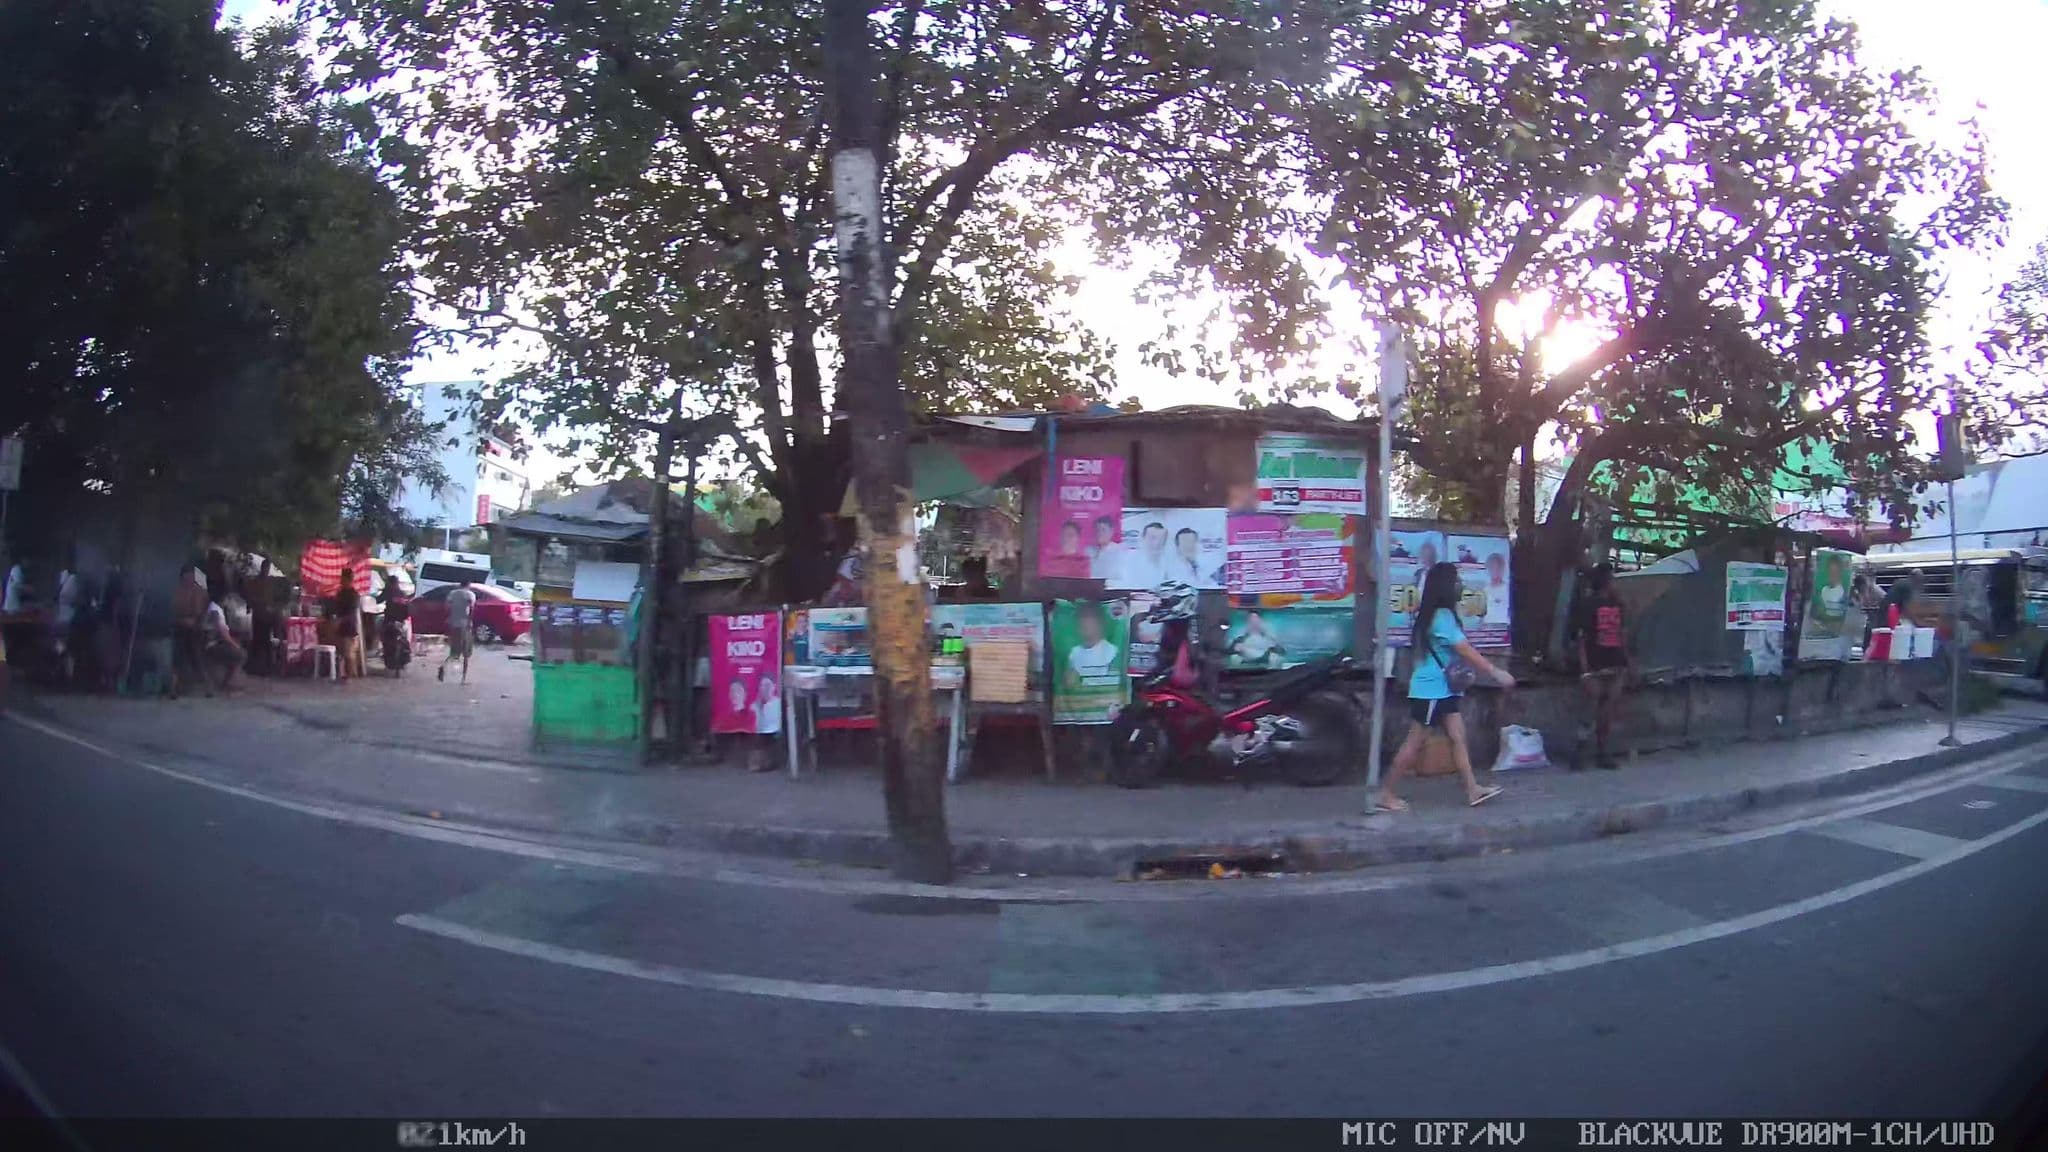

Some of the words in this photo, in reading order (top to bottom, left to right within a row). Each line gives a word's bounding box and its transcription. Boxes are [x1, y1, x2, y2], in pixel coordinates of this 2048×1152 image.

[1063, 458, 1104, 475] LENI
[1060, 486, 1104, 502] KIKO
[726, 613, 766, 631] LENI
[726, 640, 766, 657] KIKO
